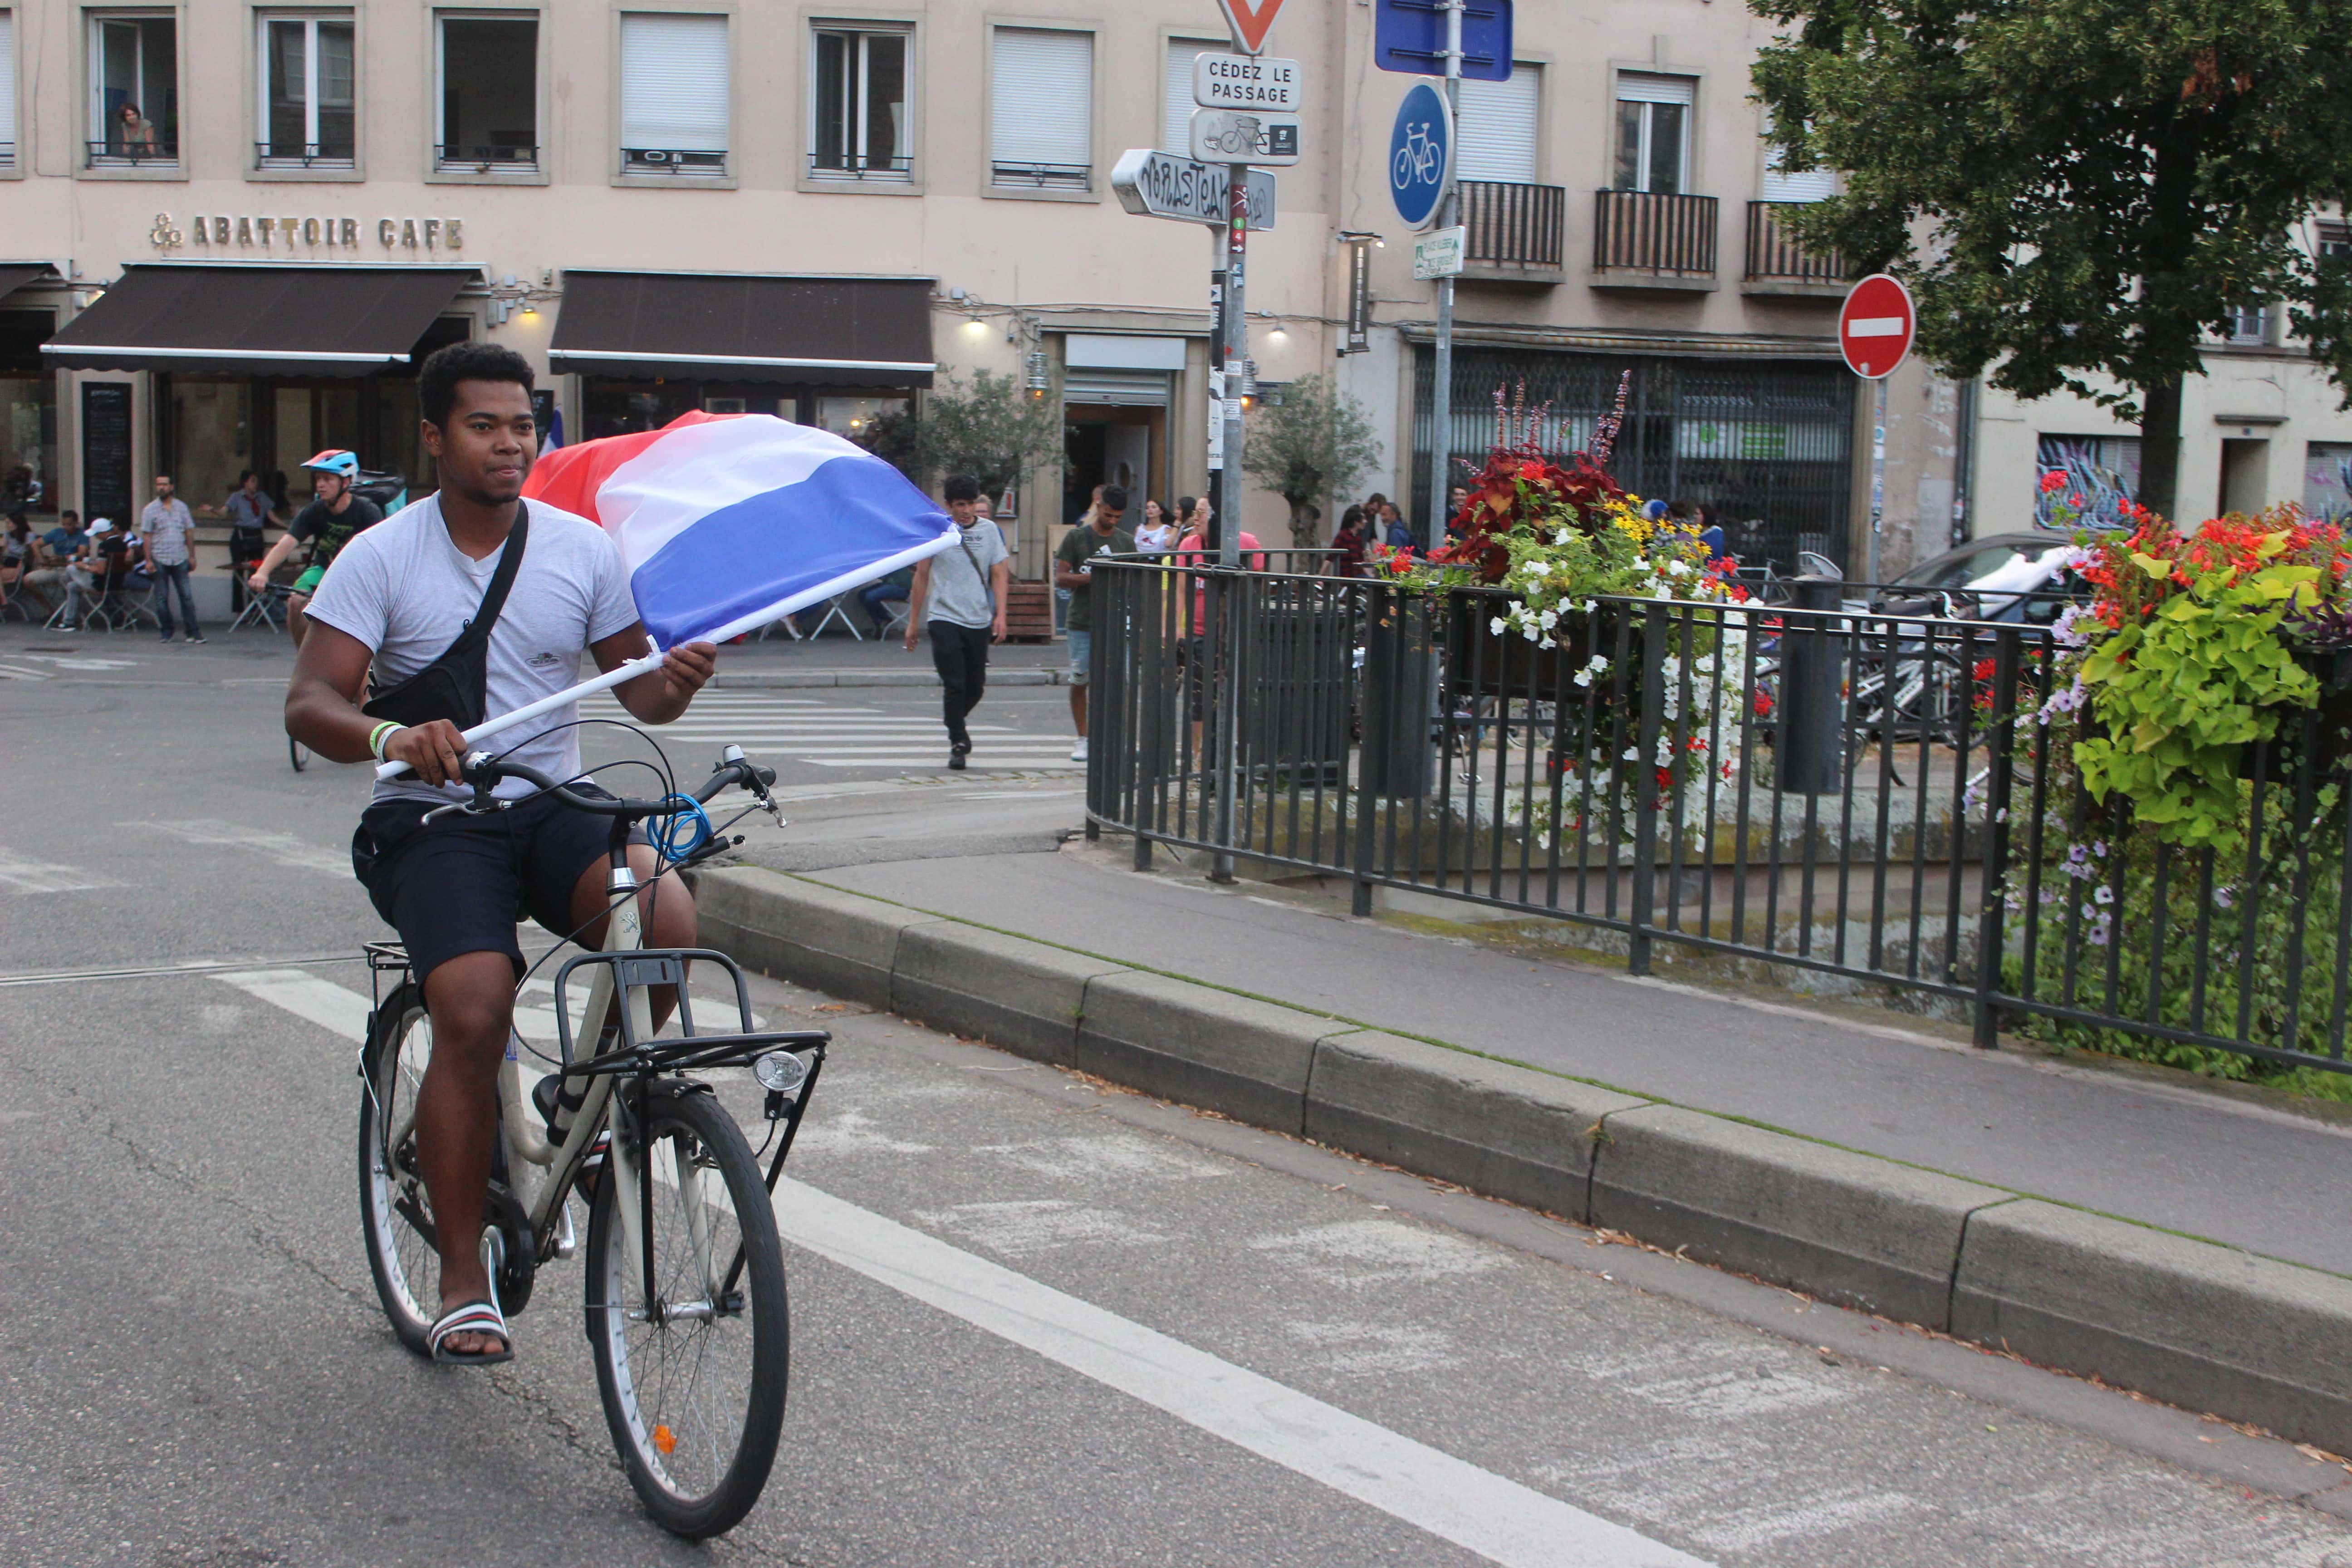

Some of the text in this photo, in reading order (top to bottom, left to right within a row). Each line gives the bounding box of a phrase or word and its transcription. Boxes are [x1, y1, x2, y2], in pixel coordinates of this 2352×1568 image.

[1209, 61, 1291, 82] CÉDEZ LE
[1212, 83, 1288, 103] PASSAGE
[193, 216, 463, 248] ABATTOIR CAFE
[1235, 232, 1242, 240] 4
